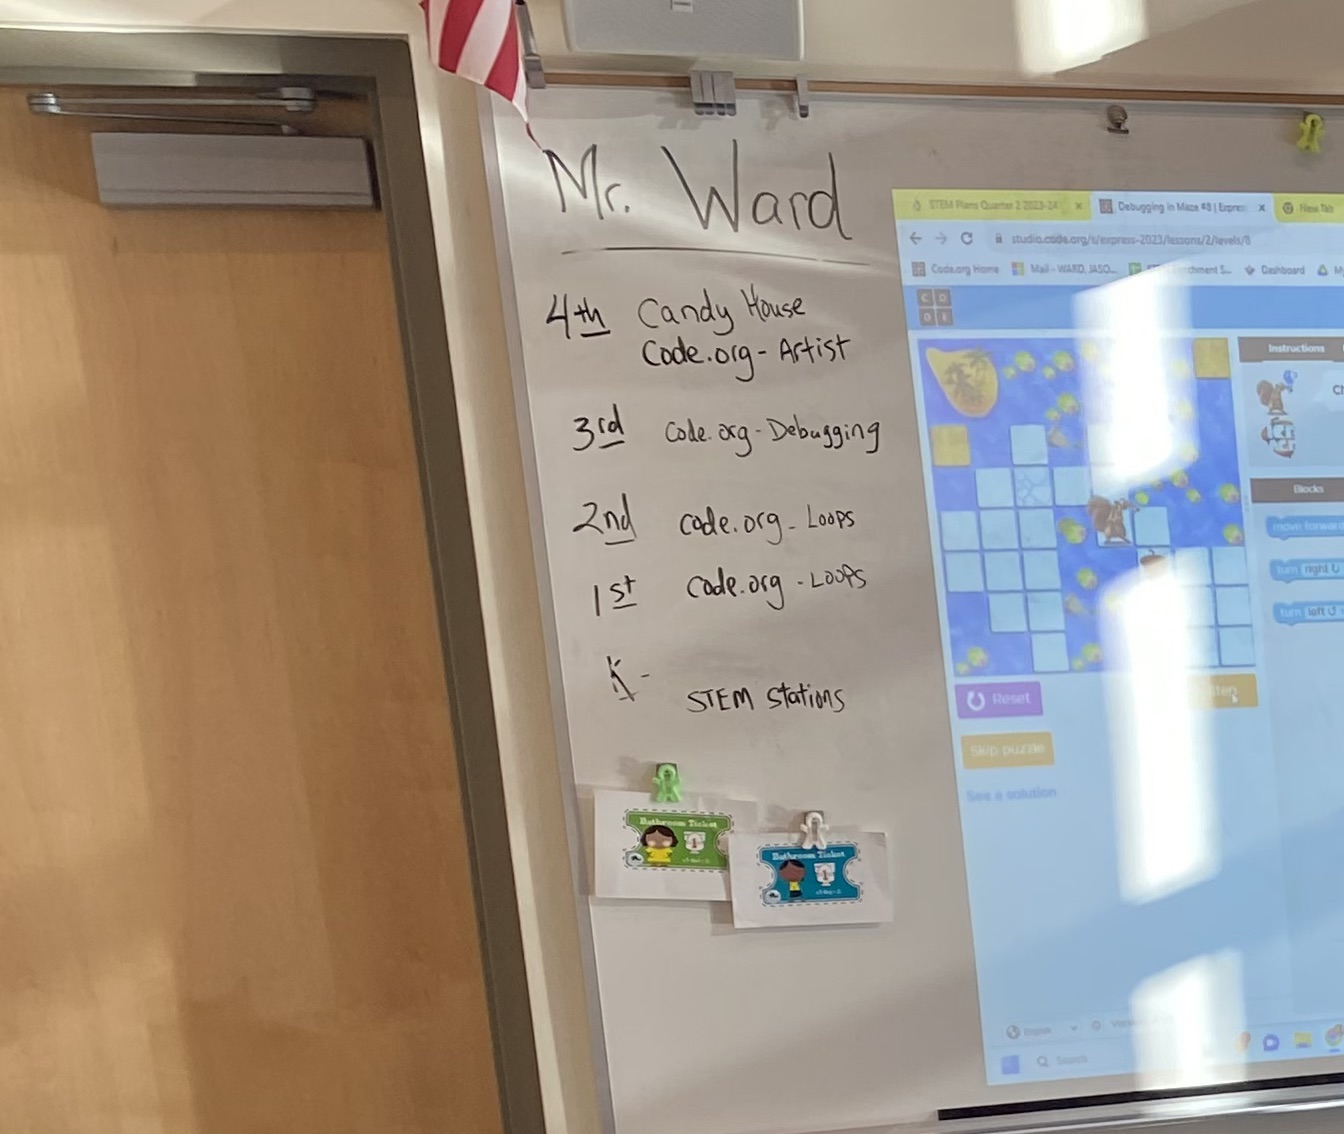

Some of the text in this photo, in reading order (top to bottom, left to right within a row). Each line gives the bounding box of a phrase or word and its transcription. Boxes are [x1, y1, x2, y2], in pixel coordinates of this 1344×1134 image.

[545, 138, 853, 240] Mr. Ward
[1118, 202, 1165, 214] Debugging
[1177, 203, 1200, 213] Maze
[1300, 203, 1334, 213] New Tab
[973, 264, 999, 274] Home
[1030, 264, 1049, 274] Mail
[1261, 266, 1305, 276] Dashboard
[546, 283, 806, 339] 4th Candy House
[779, 333, 851, 364] Artist
[1268, 343, 1325, 353] Instructions
[572, 403, 626, 450] 3rd
[1293, 483, 1324, 494] Blocks
[572, 493, 637, 545] 2nd
[806, 503, 855, 529] Loops
[1273, 519, 1344, 531] move forward
[1304, 563, 1329, 576] right
[594, 575, 638, 616] 1st
[1307, 606, 1325, 617] left
[687, 687, 754, 712] STEM
[992, 692, 1031, 705] Reset
[970, 743, 1045, 758] Skip puzzle
[966, 790, 991, 802] See
[1006, 786, 1057, 800] solution
[1056, 1055, 1088, 1065] Search
